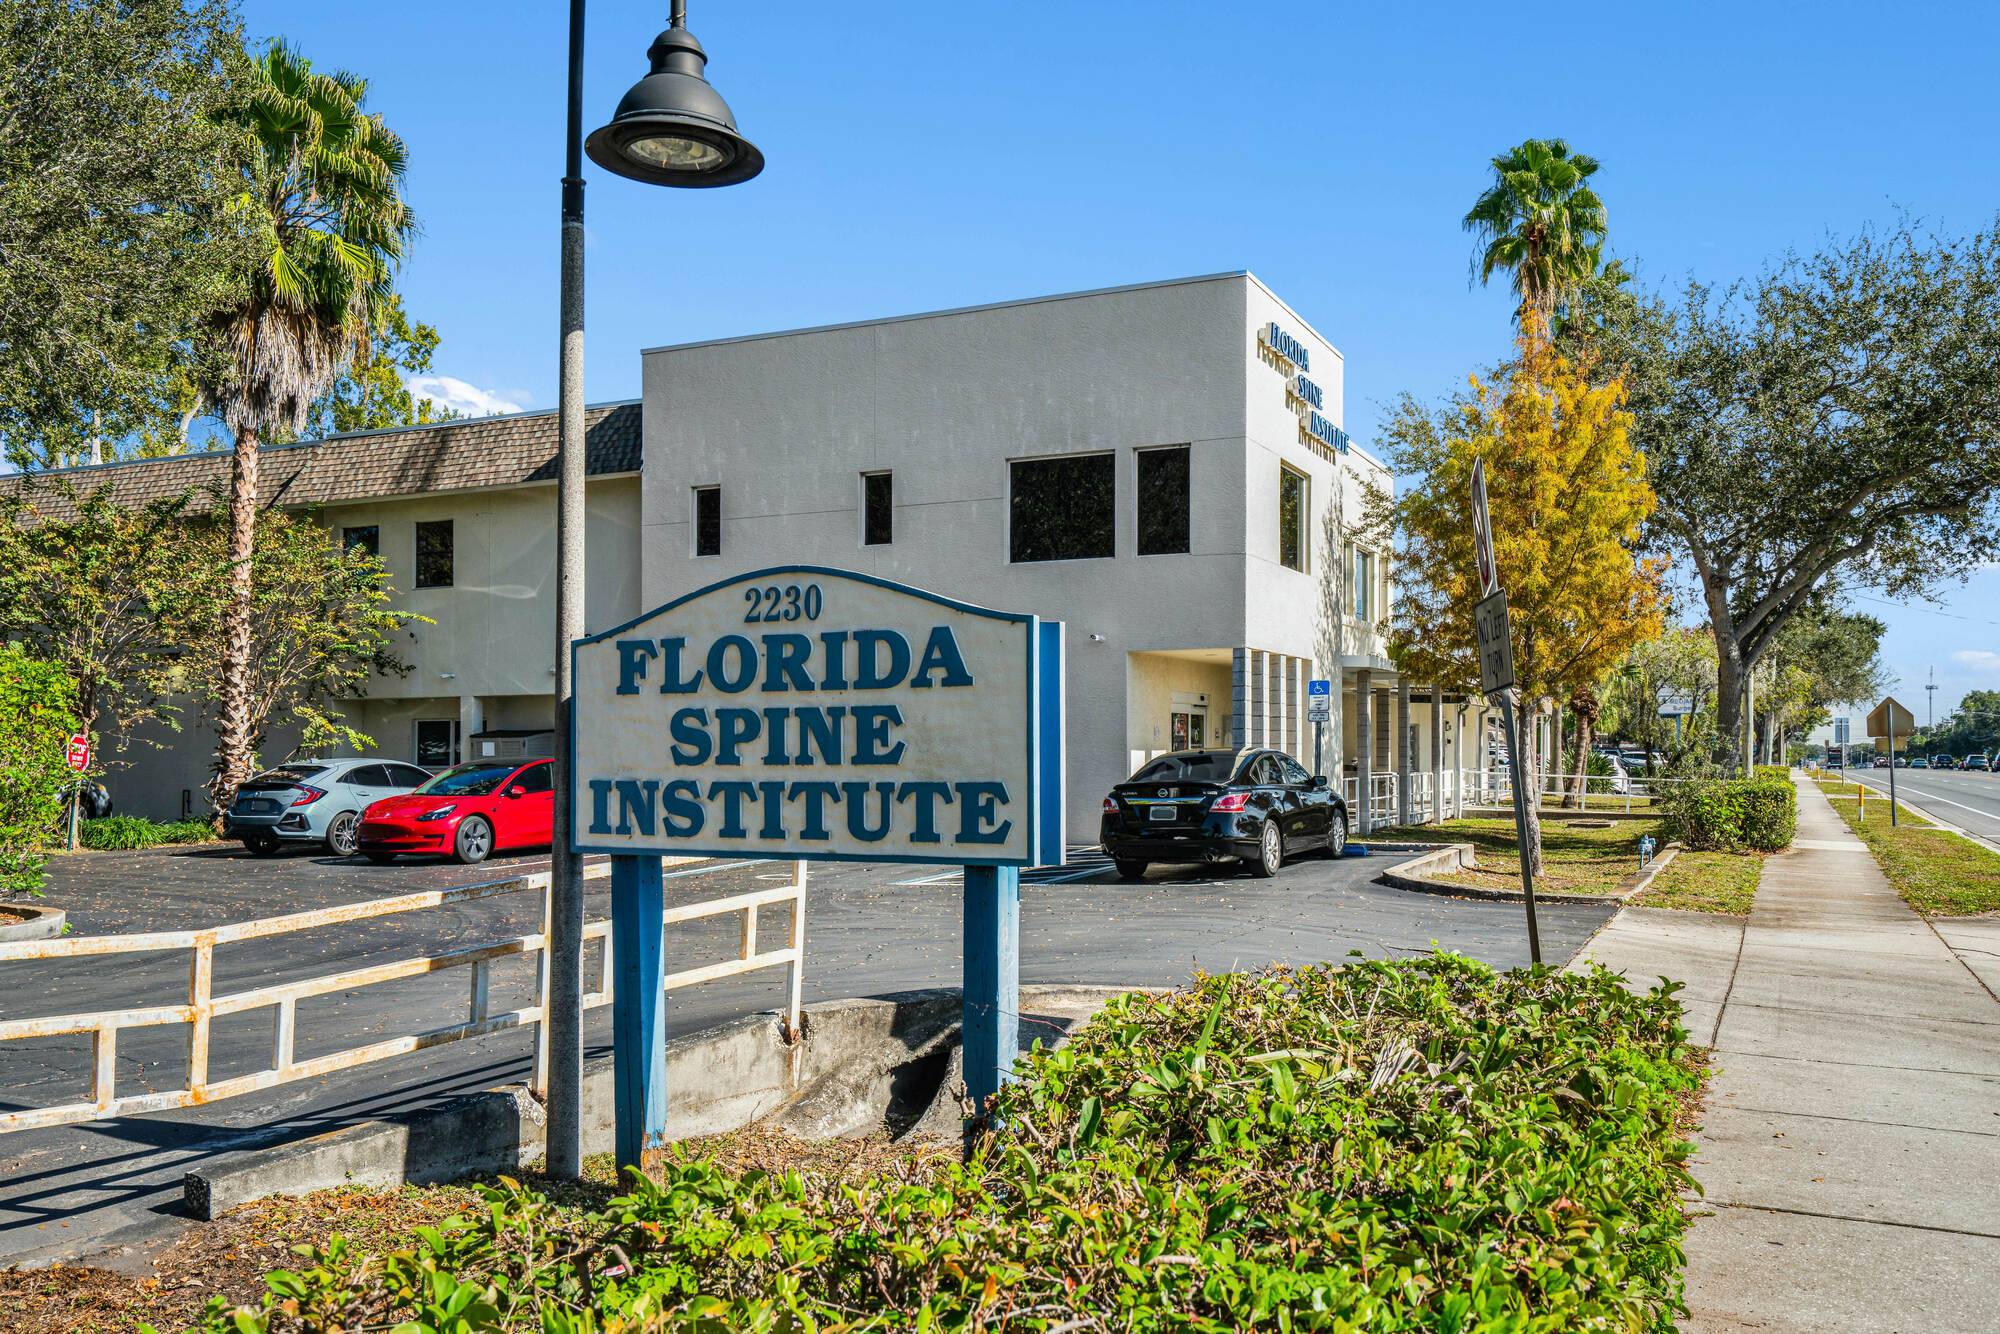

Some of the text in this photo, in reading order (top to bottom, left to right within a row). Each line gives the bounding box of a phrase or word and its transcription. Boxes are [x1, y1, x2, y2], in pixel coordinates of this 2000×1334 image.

[1270, 322, 1309, 372] FLORIDA
[1297, 374, 1323, 410] SPINE
[1310, 410, 1350, 456] INSTITUTE
[744, 584, 822, 623] 2230
[1477, 612, 1506, 647] NO LEFT
[615, 626, 975, 696] FLORIDA
[1487, 649, 1504, 676] TURN
[669, 704, 906, 766] SPINE
[588, 779, 1013, 845] INSTITUTE
